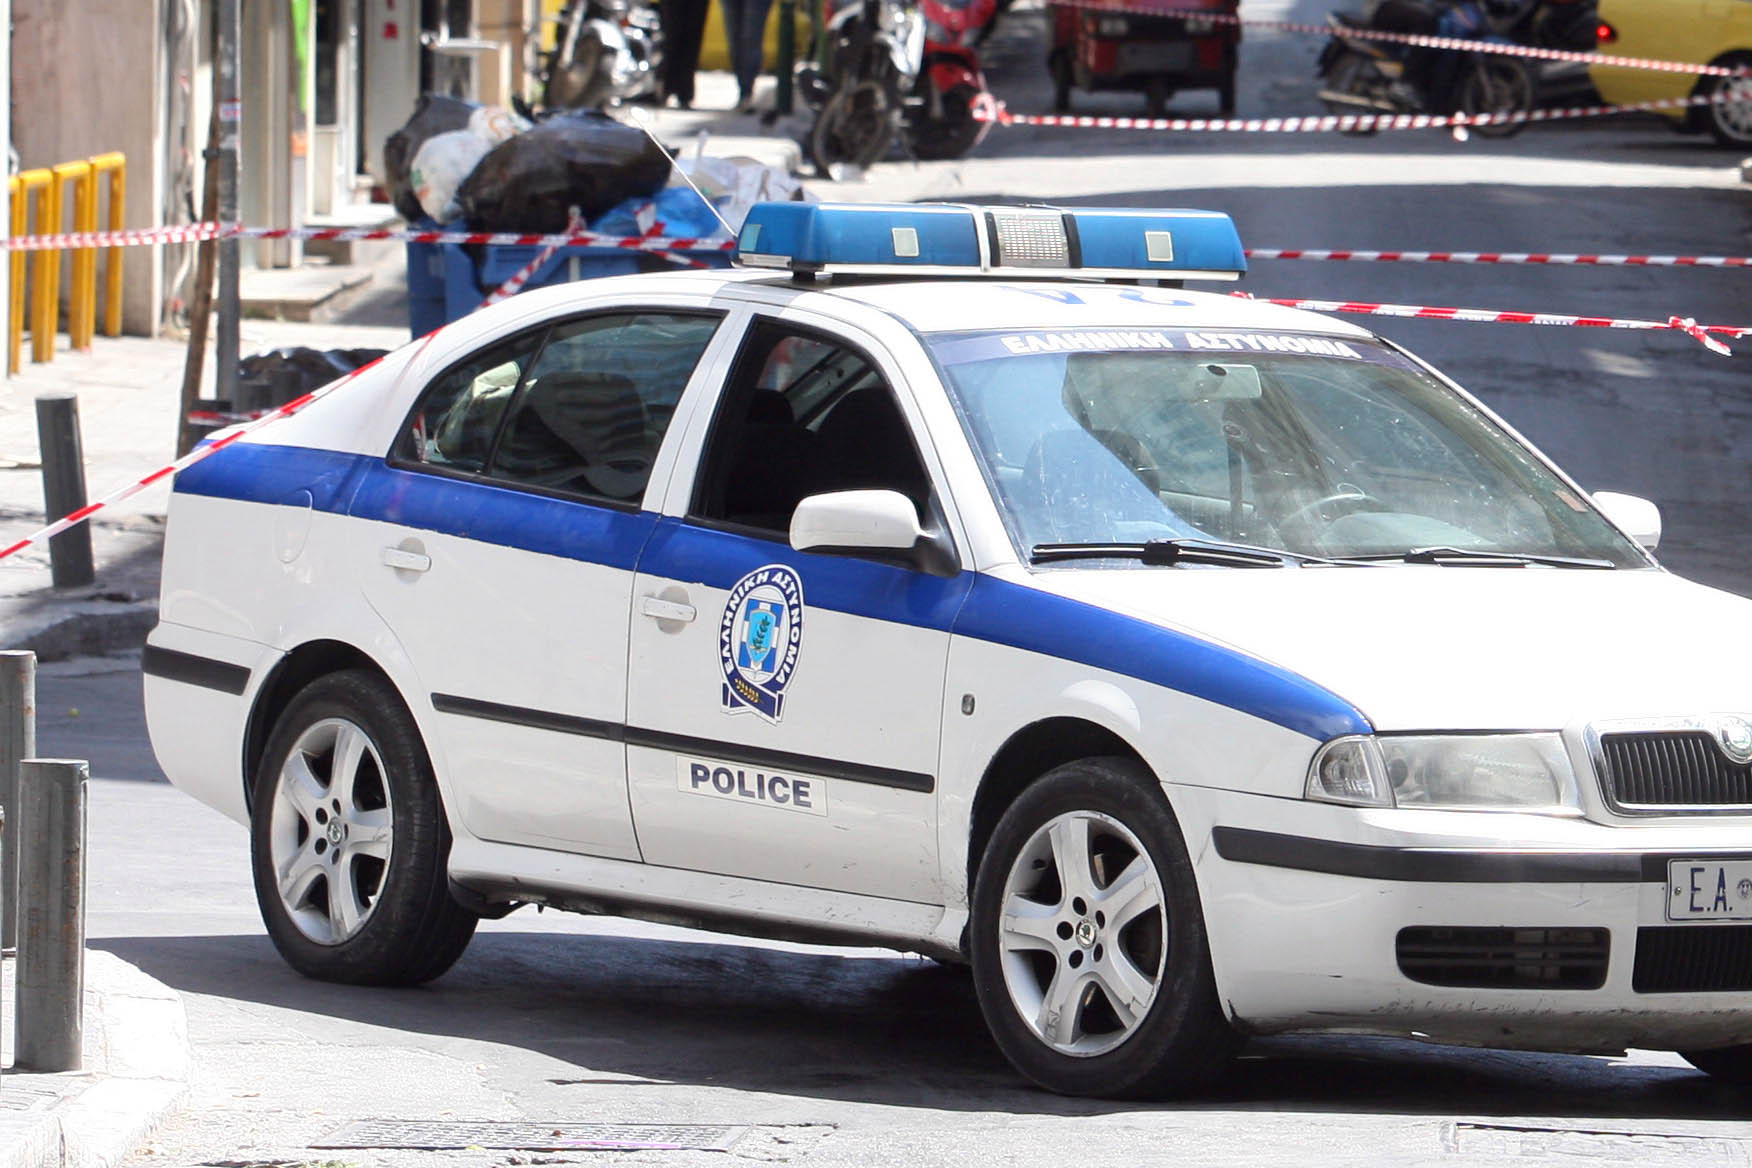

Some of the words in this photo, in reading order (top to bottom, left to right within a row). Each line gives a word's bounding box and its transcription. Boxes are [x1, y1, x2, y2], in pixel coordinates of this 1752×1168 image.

[1000, 331, 1173, 355] ΕΛΛΗΝΙΚΗ
[1187, 331, 1362, 360] ΑΣΤΥΝΟΜΙΑ
[721, 571, 769, 675] ΕΛΛΗΝΙΚΗ
[771, 571, 801, 684] ΑΣΤΥΝΟΜΙΑ
[690, 762, 812, 808] POLICE
